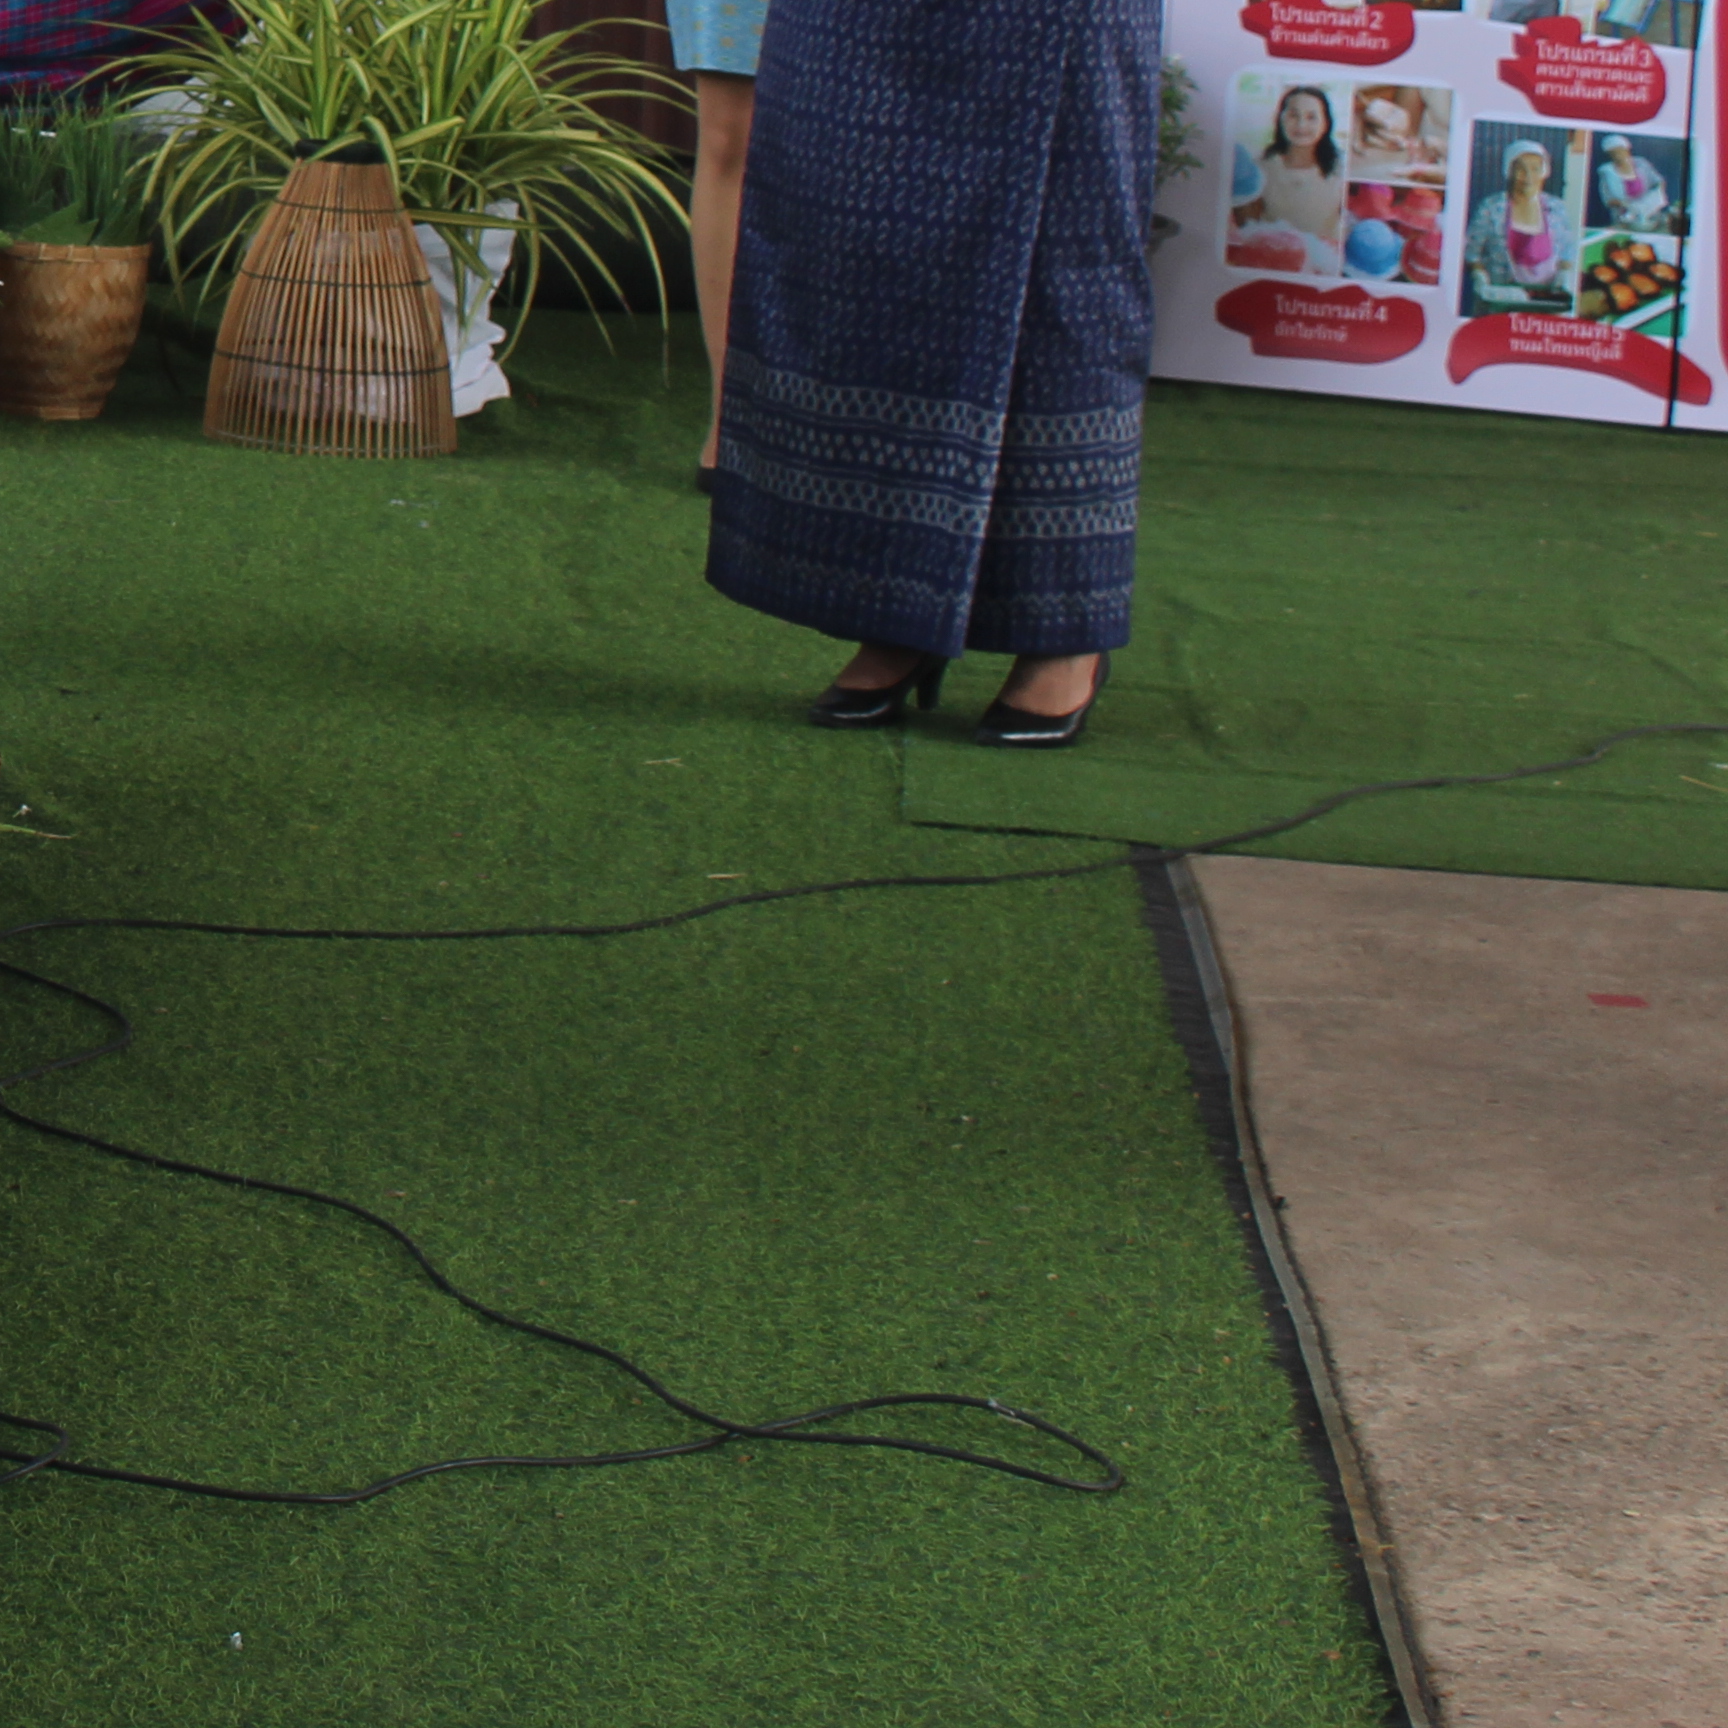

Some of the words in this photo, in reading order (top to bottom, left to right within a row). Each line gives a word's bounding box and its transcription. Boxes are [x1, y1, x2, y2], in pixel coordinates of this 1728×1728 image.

[1270, 1, 1368, 28] โปรแกรมที่
[1535, 38, 1635, 66] โปรแกรมที่
